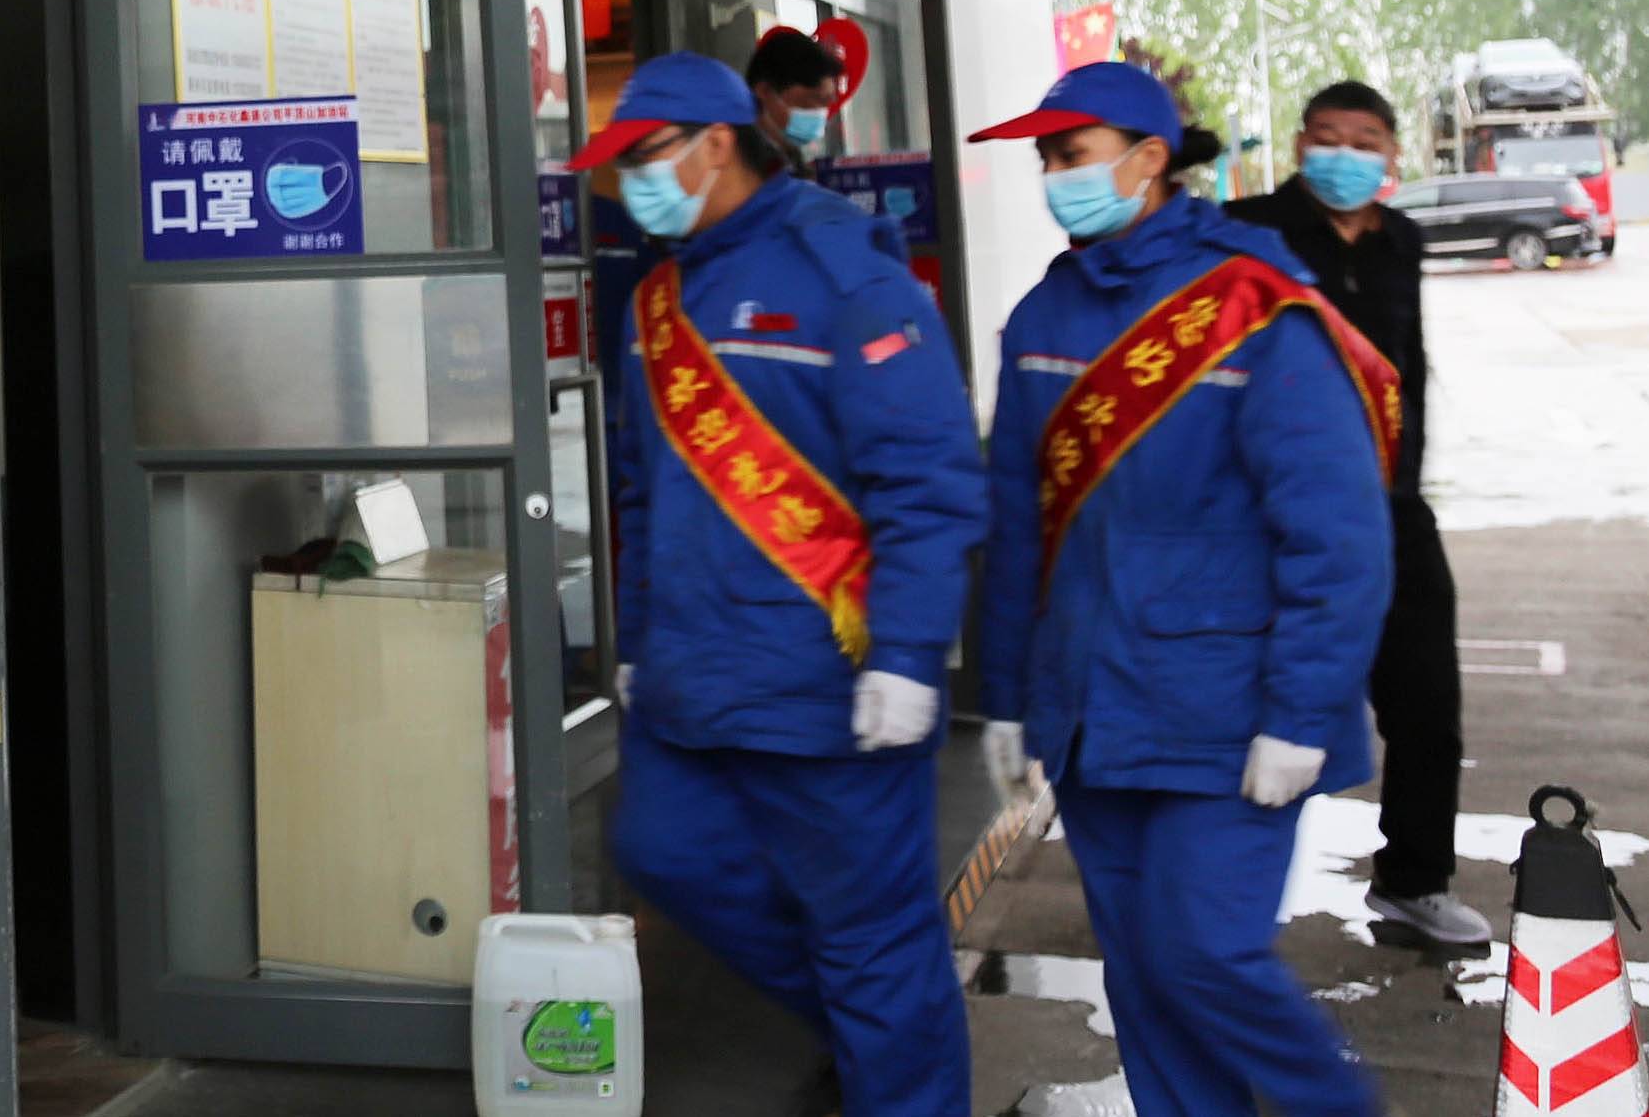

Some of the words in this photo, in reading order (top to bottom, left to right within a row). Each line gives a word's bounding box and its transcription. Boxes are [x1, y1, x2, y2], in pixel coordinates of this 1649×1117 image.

[162, 136, 245, 166] 请佩戴
[151, 169, 259, 238] 口罩
[282, 232, 345, 250] 谢谢合作
